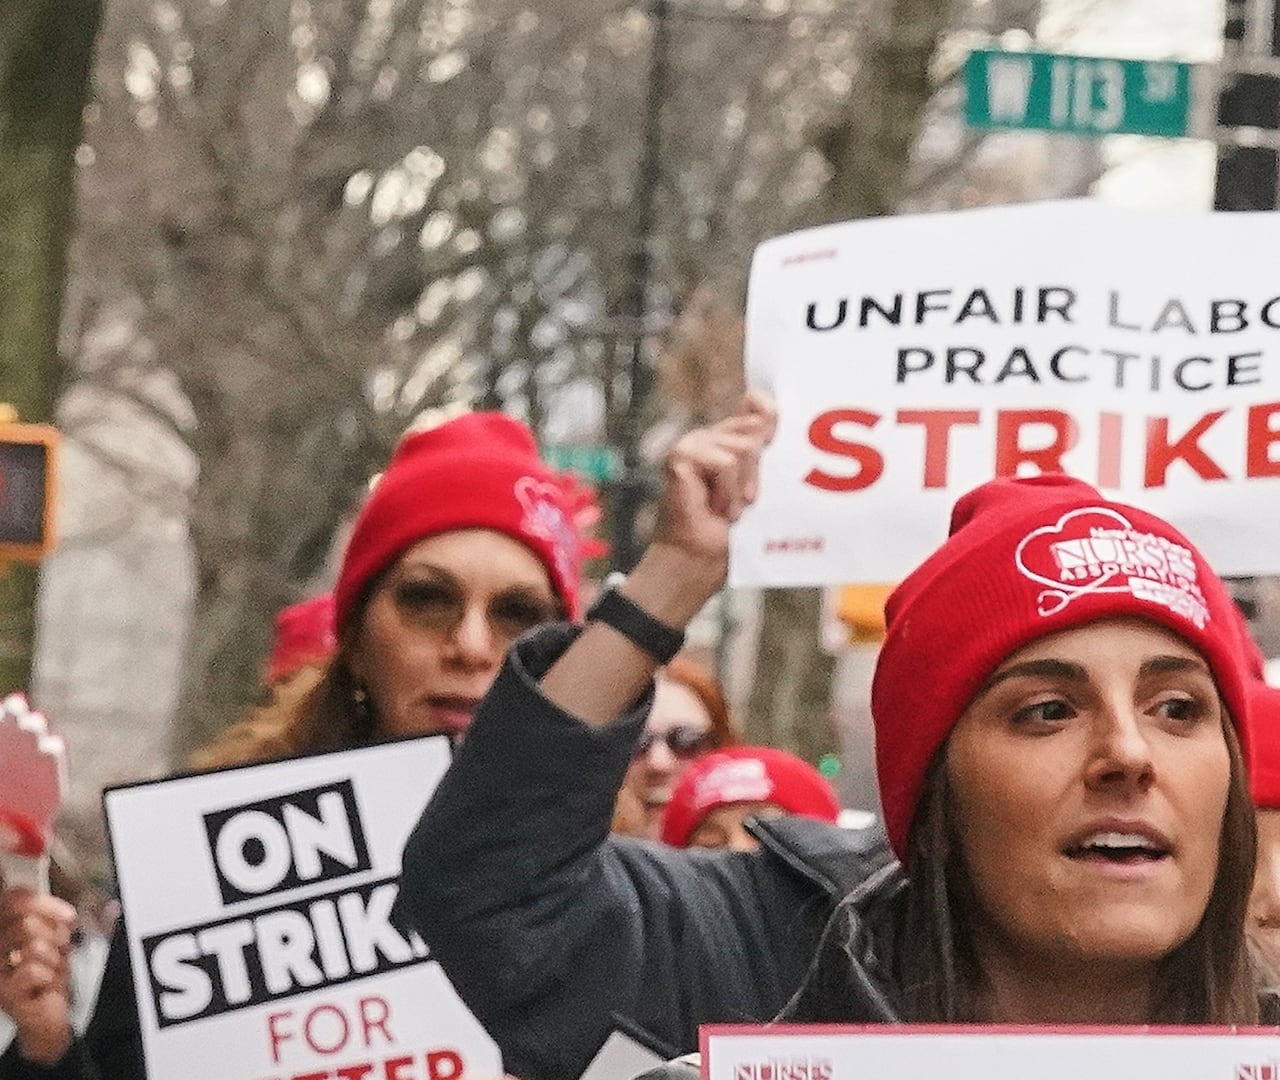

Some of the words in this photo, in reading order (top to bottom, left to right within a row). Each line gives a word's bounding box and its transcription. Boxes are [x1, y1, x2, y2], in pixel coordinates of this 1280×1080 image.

[988, 55, 1033, 123] W
[805, 286, 1079, 333] UNFAIR
[895, 344, 1266, 392] PRACTICE
[215, 792, 358, 893] ON
[151, 884, 430, 1020] STRIK
[268, 995, 393, 1063] FOR
